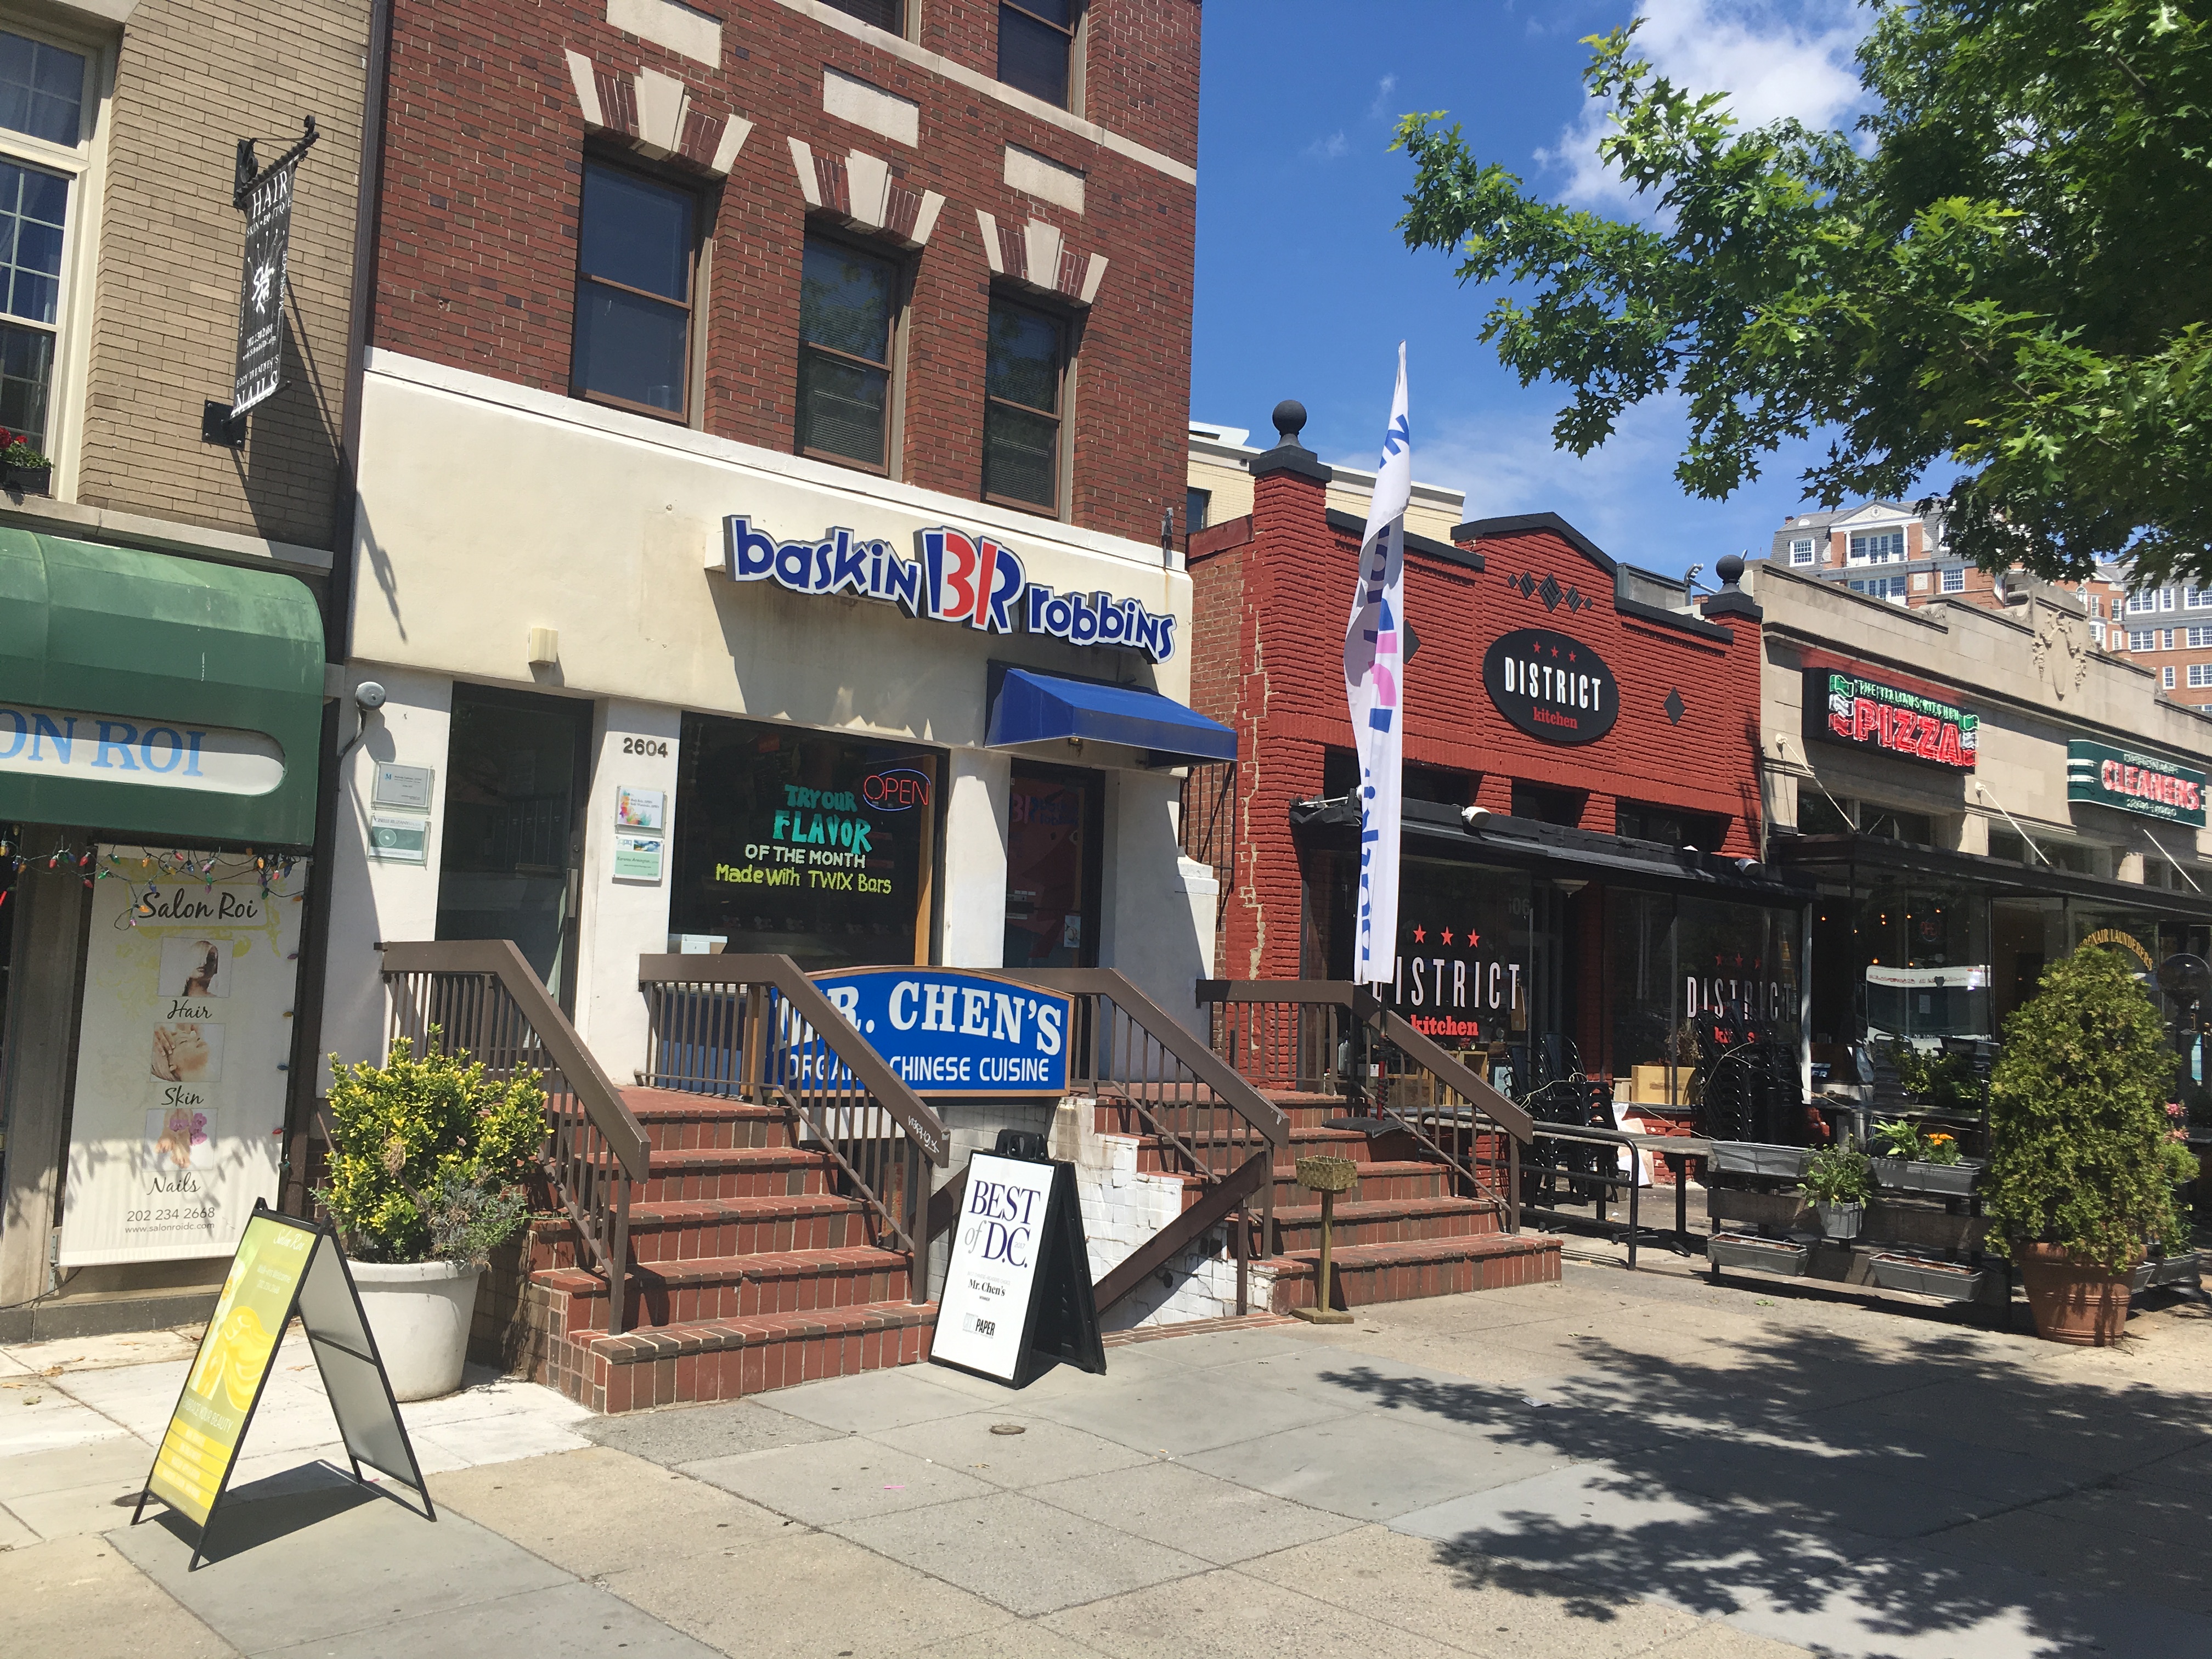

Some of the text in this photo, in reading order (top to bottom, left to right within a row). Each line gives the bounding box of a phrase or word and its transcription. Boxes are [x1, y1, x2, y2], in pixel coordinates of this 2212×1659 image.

[252, 171, 287, 219] HAIR
[732, 518, 921, 614] baskin
[1028, 584, 1177, 663] robbins
[1505, 657, 1601, 711] DISTRICT
[1533, 707, 1578, 729] kitchen
[1854, 697, 1963, 766] PIZZA
[91, 720, 206, 777] ROI
[623, 737, 668, 758] 2604
[785, 784, 857, 812] TRY OUR
[864, 775, 930, 805] OPEN
[2102, 759, 2199, 810] CLEANERS
[773, 810, 872, 854] FLAVOR
[745, 843, 866, 868] OF THE MONTH
[715, 863, 892, 894] Made With TWIX Bars
[138, 891, 258, 919] Salon Roi
[2111, 928, 2153, 971] LAUNDERERS
[167, 999, 213, 1020] Hair
[889, 981, 1062, 1056] CHEN'S
[1410, 1014, 1479, 1036] kitchen
[980, 1058, 1049, 1082] CUISINE
[161, 1086, 204, 1107] Skin
[146, 1176, 201, 1196] Nails
[127, 1207, 215, 1222] 202 234 2668
[968, 1180, 1041, 1225] BEST
[125, 1221, 215, 1234] www.salonroidc.com
[273, 1228, 308, 1251] Salon Roi
[964, 1220, 1031, 1268] of D.C.
[968, 1279, 1006, 1296] Mr. Chen's
[975, 1318, 996, 1336] PAPER
[210, 1412, 234, 1434] BEAUTY
